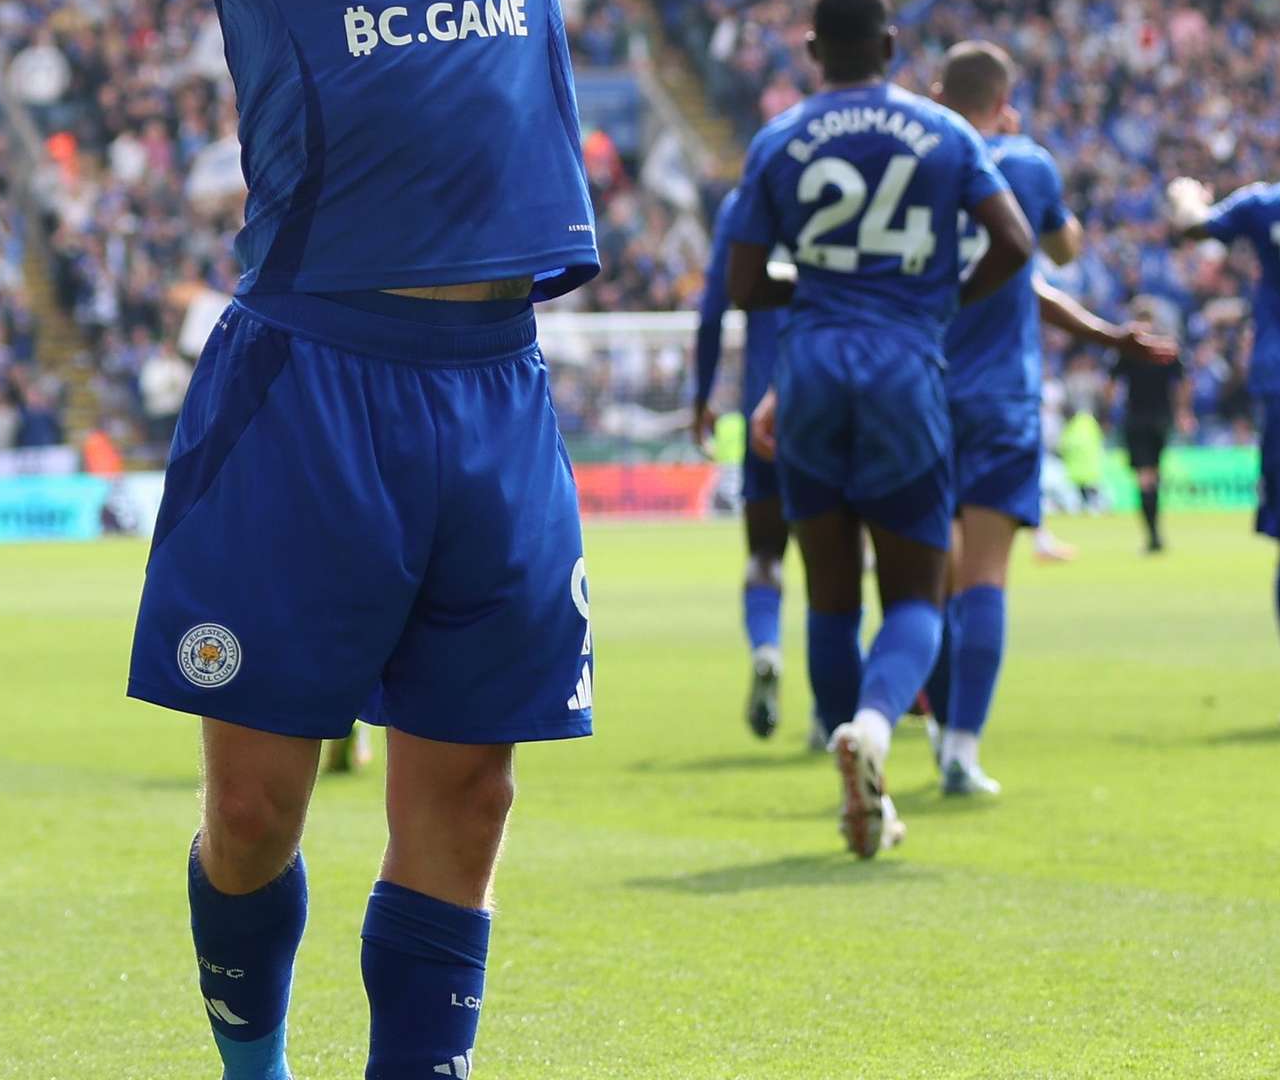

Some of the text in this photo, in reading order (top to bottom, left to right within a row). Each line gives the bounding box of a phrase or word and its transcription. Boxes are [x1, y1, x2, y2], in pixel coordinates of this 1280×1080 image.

[797, 156, 937, 275] 24
[186, 628, 236, 660] LEICESTER CITY
[182, 652, 233, 682] FOOTBALL CLUB
